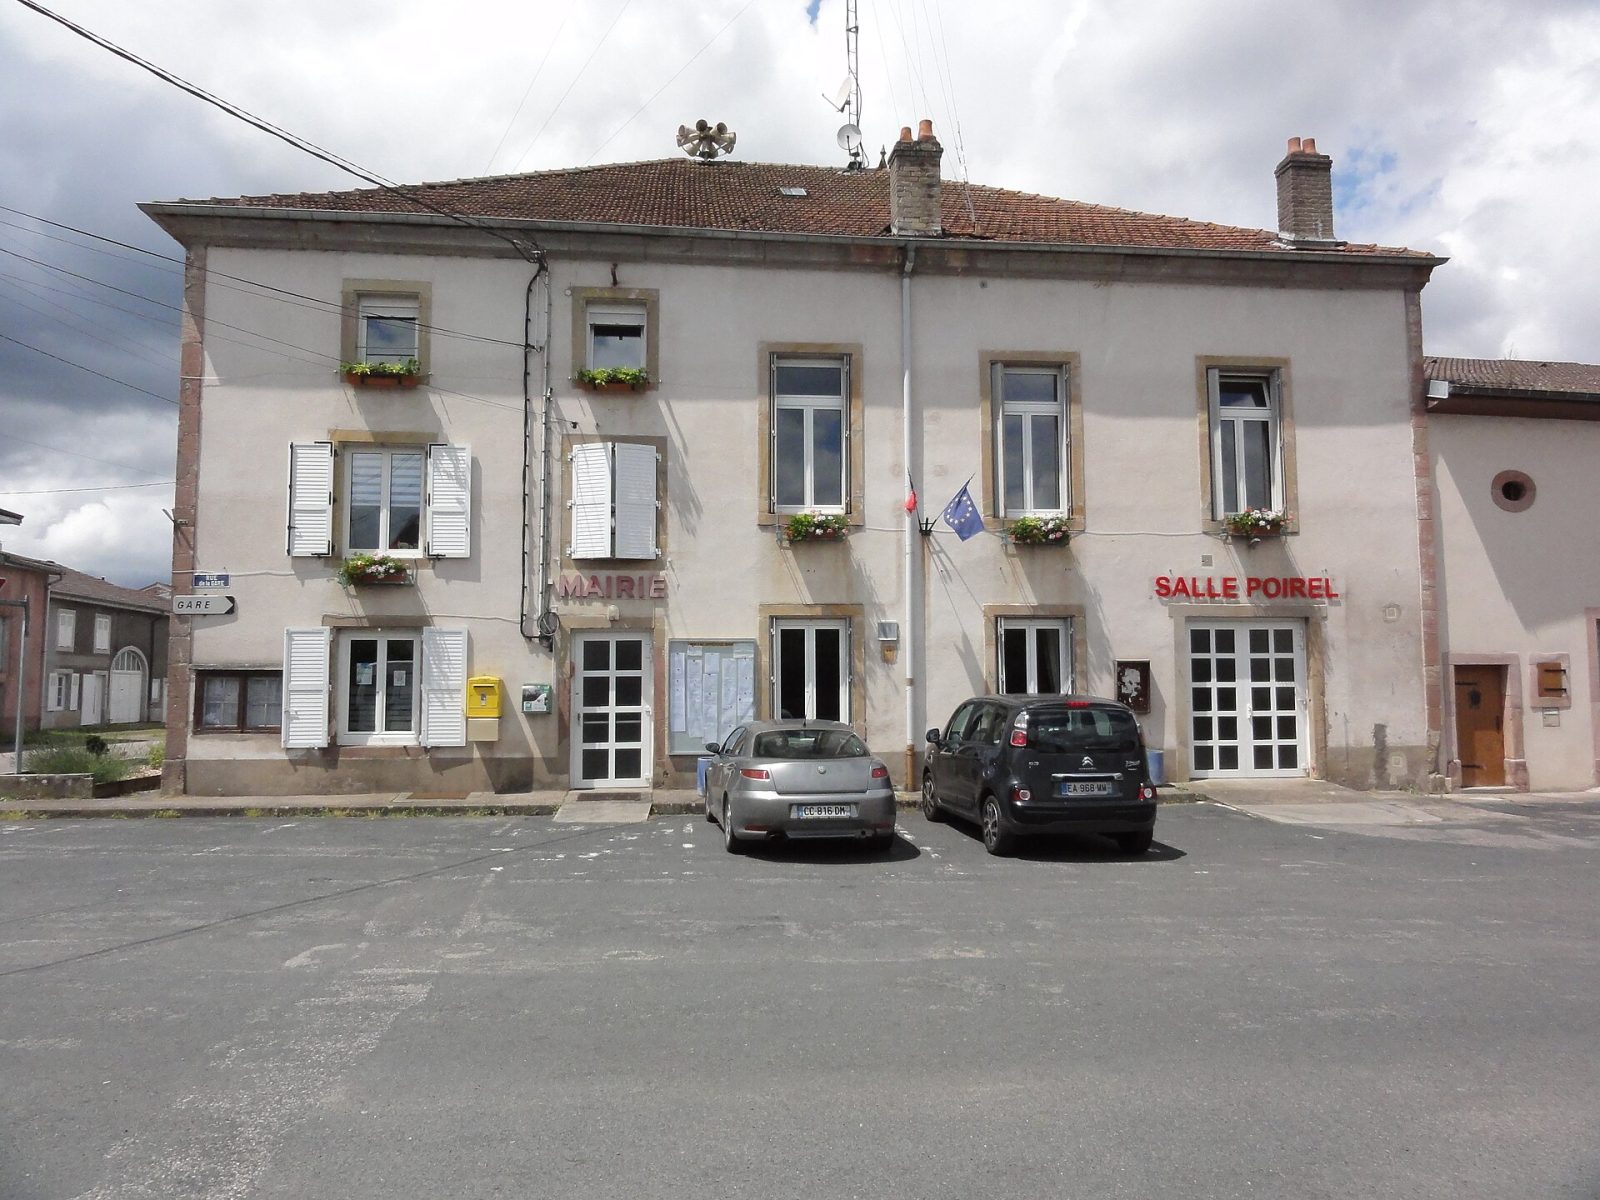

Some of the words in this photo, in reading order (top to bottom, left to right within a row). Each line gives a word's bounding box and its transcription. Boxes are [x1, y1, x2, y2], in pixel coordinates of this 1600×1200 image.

[559, 574, 665, 598] MAIRIE
[1155, 576, 1239, 599] SALLE
[1246, 577, 1339, 599] POIREL
[177, 600, 211, 610] GARE
